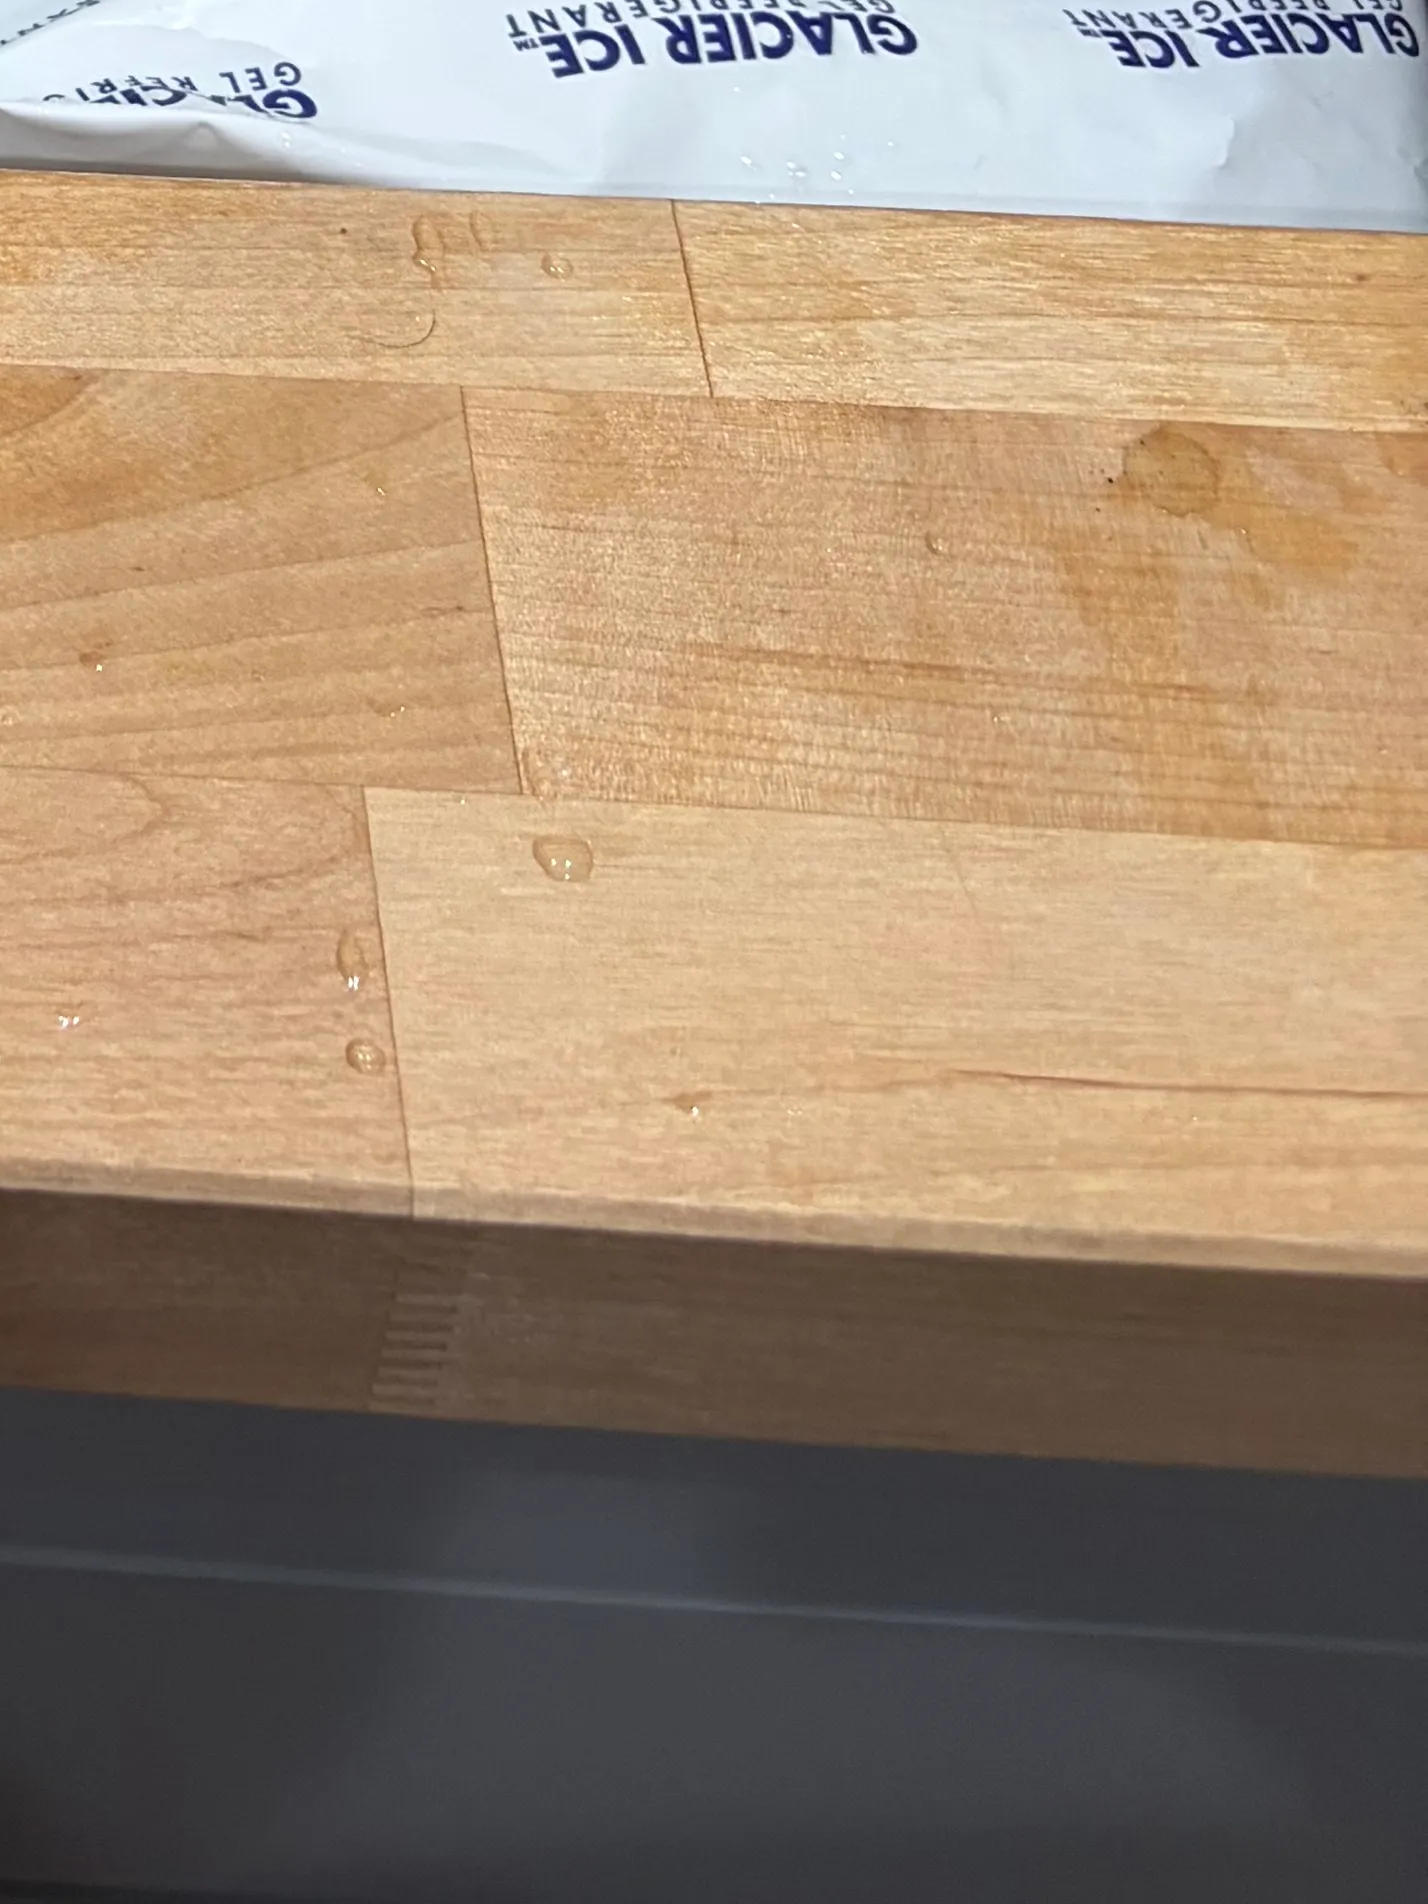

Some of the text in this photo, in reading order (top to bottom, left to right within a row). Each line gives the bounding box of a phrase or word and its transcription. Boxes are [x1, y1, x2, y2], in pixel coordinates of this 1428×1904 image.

[650, 9, 919, 65] GLACIER
[1194, 12, 1421, 59] GLACIER
[218, 61, 302, 94] GEL
